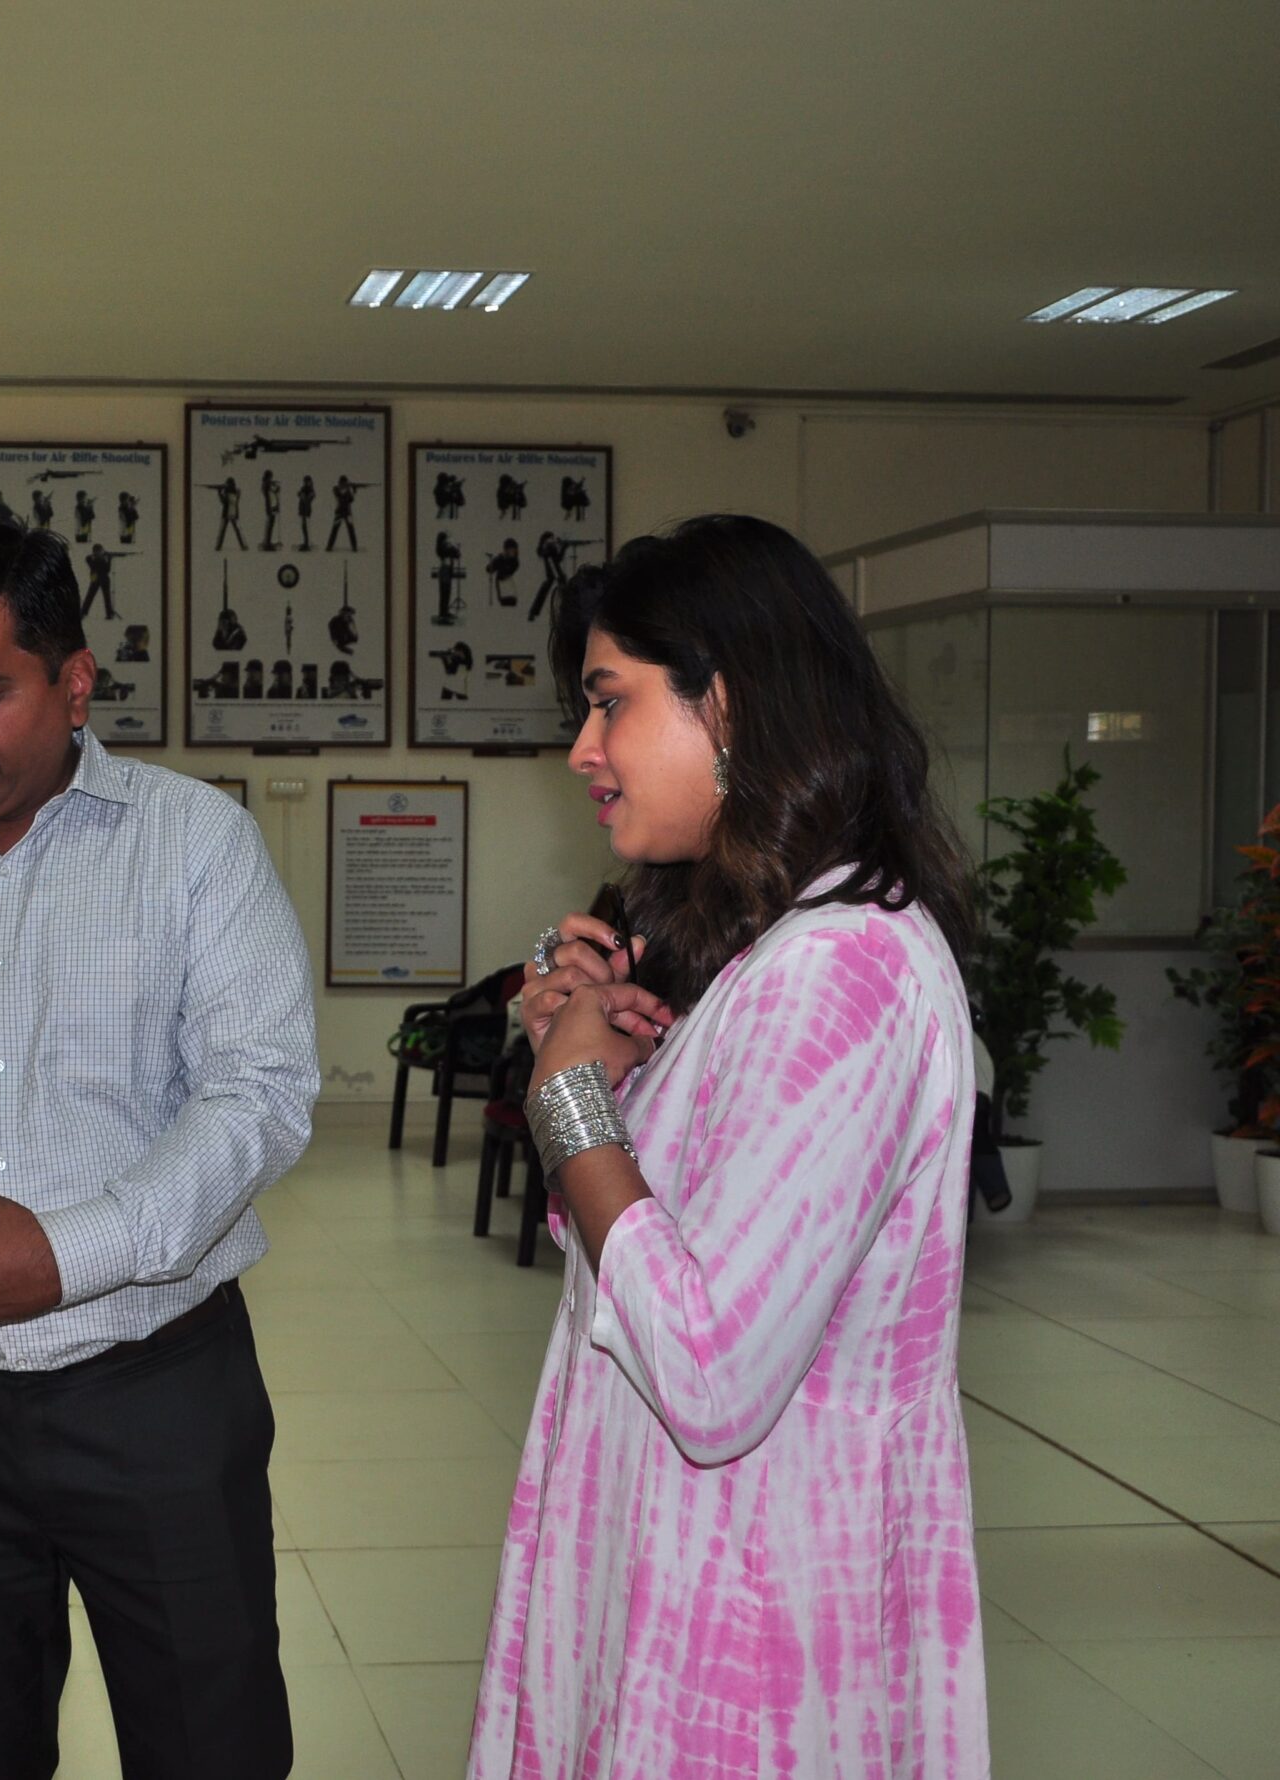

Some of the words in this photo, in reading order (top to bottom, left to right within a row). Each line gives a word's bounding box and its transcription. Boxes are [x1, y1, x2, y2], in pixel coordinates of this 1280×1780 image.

[200, 413, 252, 426] Postures
[254, 413, 270, 426] for
[273, 414, 289, 426] Air
[325, 415, 375, 430] Shooting
[32, 451, 48, 463] for
[50, 451, 66, 463] Air
[101, 452, 151, 466] Shooting
[426, 451, 477, 463] Postures
[478, 452, 494, 464] for
[497, 452, 513, 464] Air
[547, 453, 597, 467] Shooting
